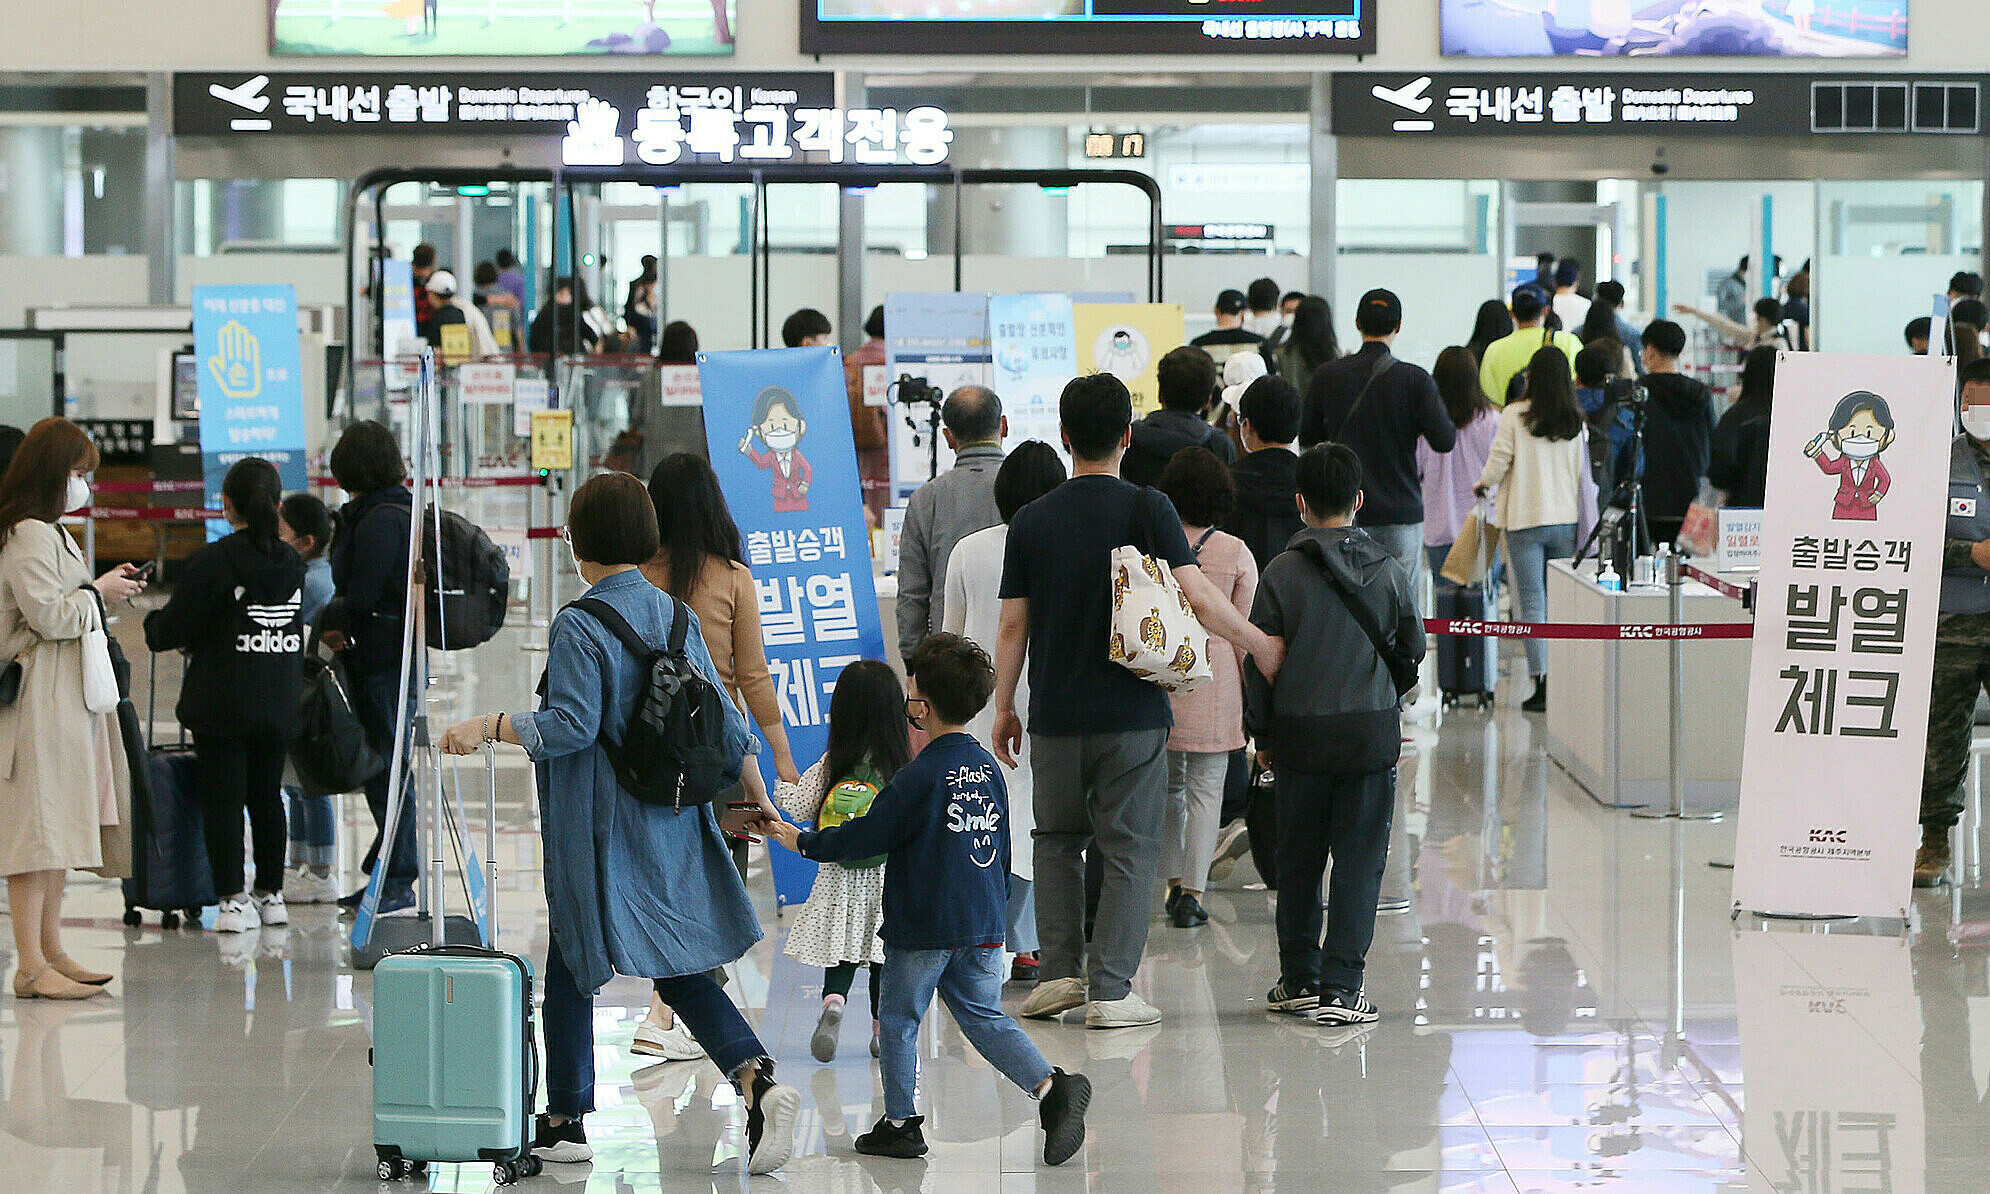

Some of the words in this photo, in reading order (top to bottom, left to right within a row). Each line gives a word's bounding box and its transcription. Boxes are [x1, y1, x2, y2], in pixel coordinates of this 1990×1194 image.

[283, 85, 381, 122] 국내선
[385, 84, 453, 122] 출발
[1446, 86, 1544, 123] 국내선
[1548, 85, 1617, 123] 출발
[1621, 88, 1681, 105] Domestic
[1682, 88, 1754, 107] Departures
[747, 526, 846, 565] 출발승객
[1792, 536, 1912, 573] 출발승객
[754, 572, 860, 646] 발열
[1449, 621, 1482, 635] KAC
[1785, 584, 1909, 656] 발열
[1620, 625, 1653, 638] KAC
[1774, 664, 1901, 739] 체크
[1809, 829, 1847, 843] KAC
